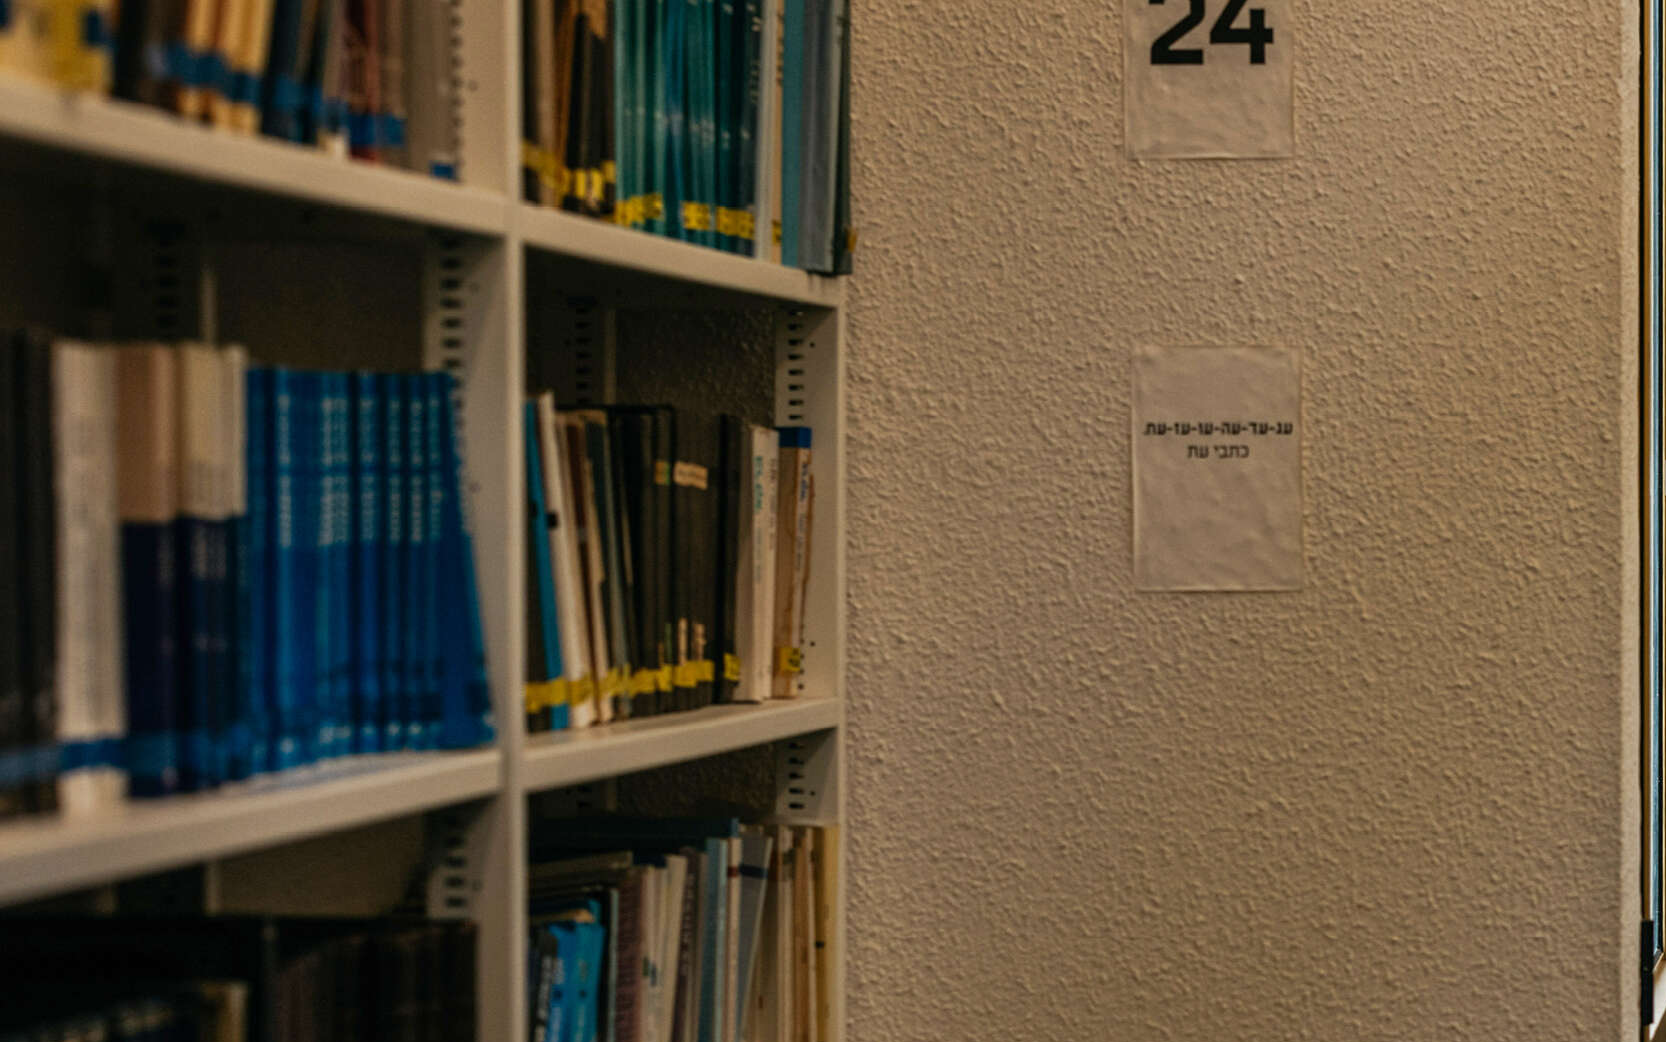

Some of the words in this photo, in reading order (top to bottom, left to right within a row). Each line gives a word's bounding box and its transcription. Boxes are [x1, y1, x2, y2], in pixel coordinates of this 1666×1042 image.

[1148, 0, 1274, 65] 24
[1188, 445, 1209, 458] עת
[1214, 445, 1249, 458] כתבי
